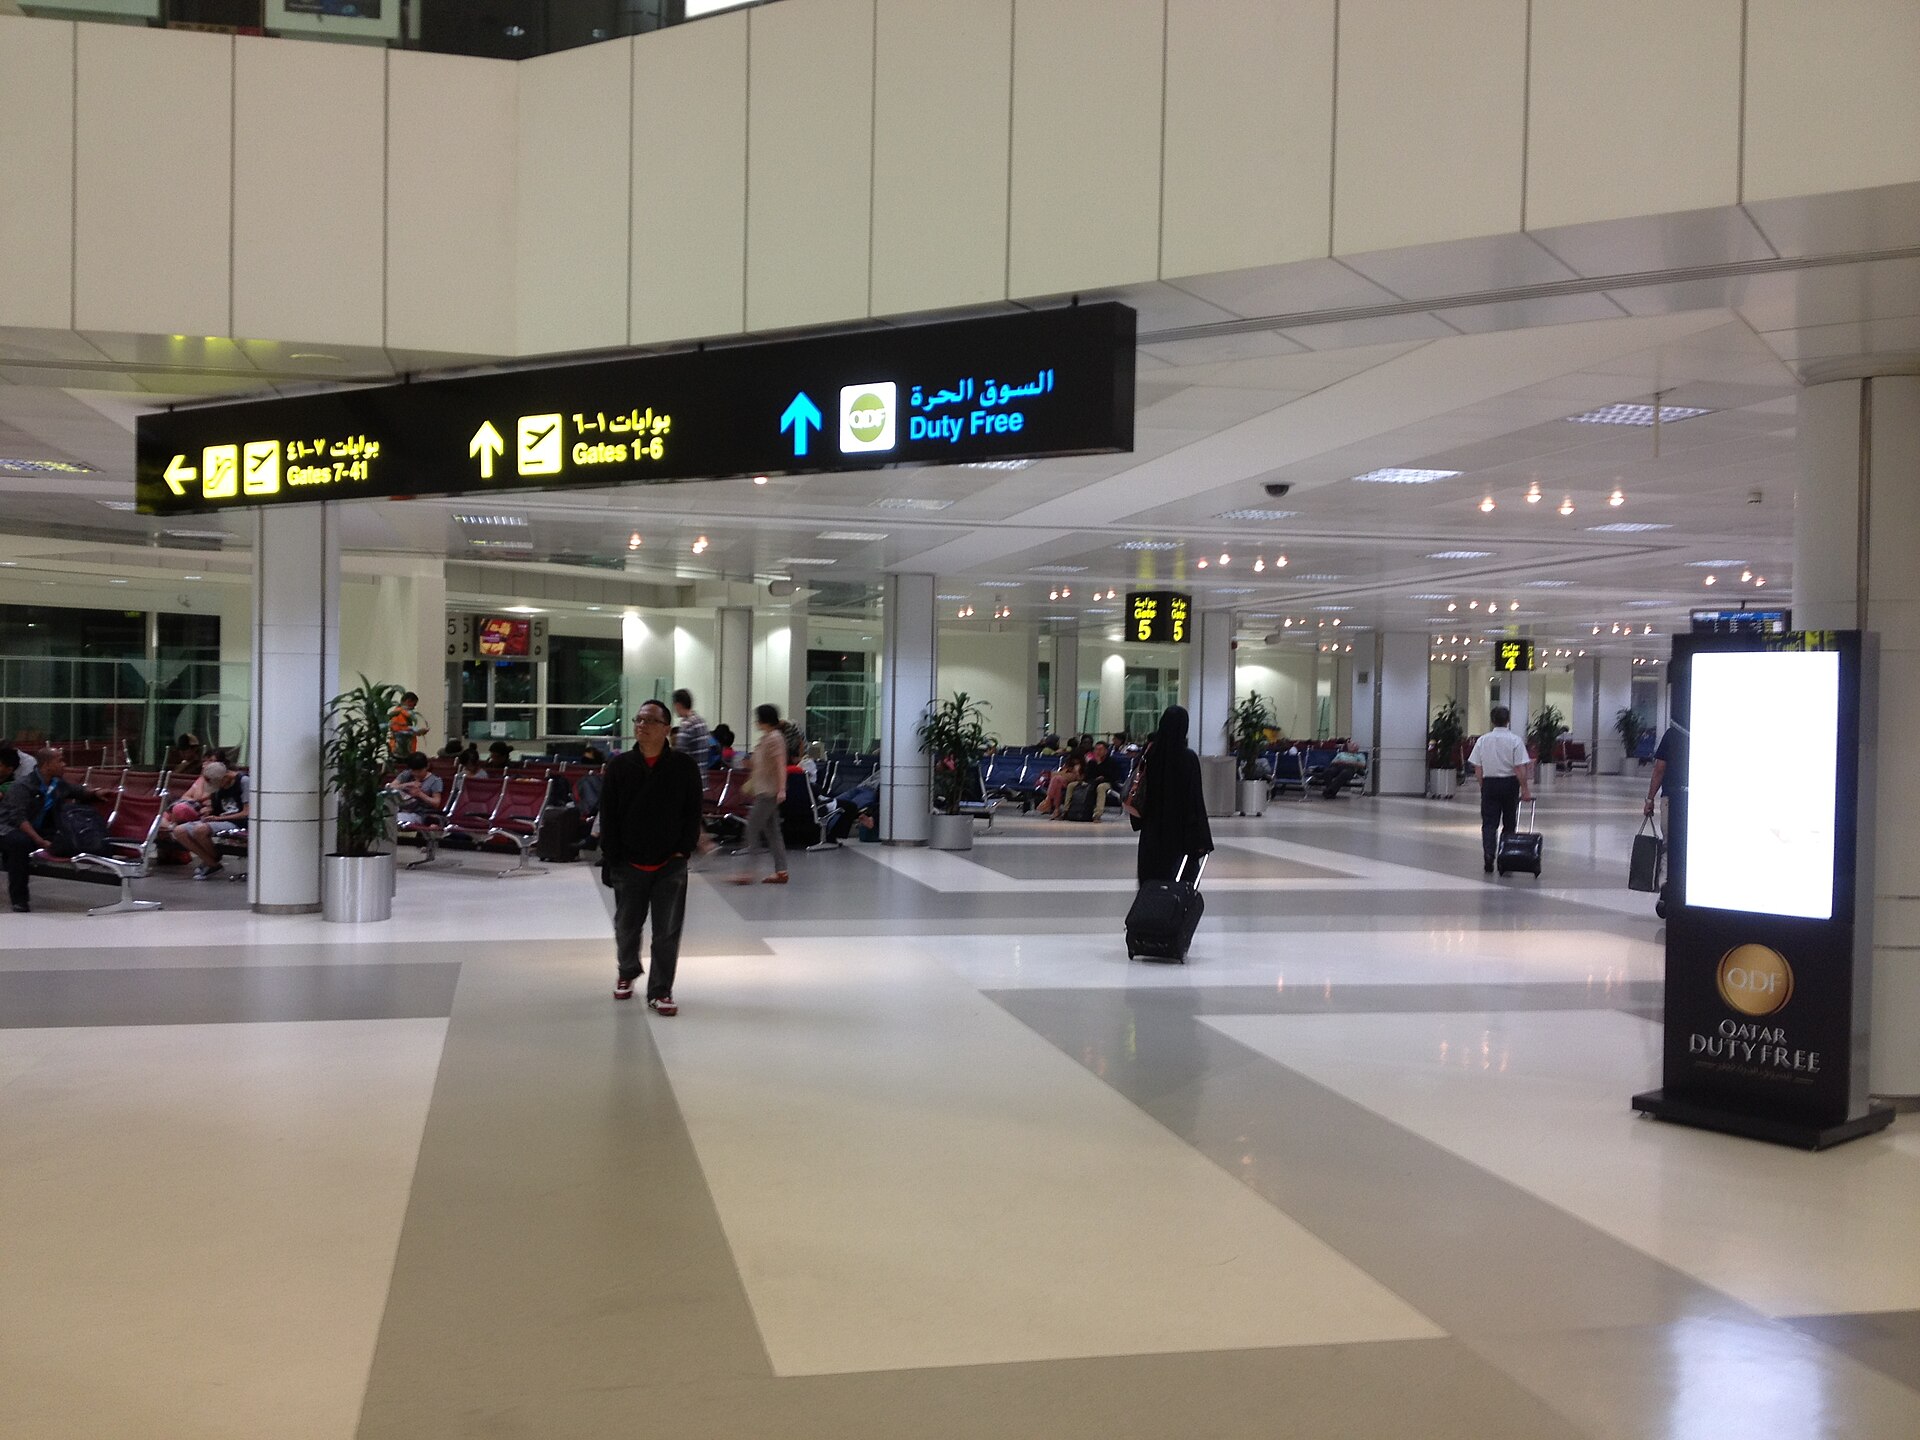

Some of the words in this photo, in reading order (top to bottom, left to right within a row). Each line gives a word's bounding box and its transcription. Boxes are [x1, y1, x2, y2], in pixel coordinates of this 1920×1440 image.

[910, 377, 973, 411] الحرة
[979, 368, 1054, 407] السوق
[609, 407, 671, 435] بوابات
[909, 414, 964, 443] Duty
[970, 410, 1024, 435] Free
[329, 434, 380, 460] بوابات
[572, 442, 627, 465] Gates
[631, 436, 664, 460] 1-6
[286, 465, 332, 486] Gates
[332, 460, 368, 482] 7-41
[447, 619, 457, 635] 5
[533, 622, 543, 638] 5
[1138, 620, 1152, 641] 5
[1173, 620, 1184, 642] 5
[1718, 1018, 1788, 1045] QATAR
